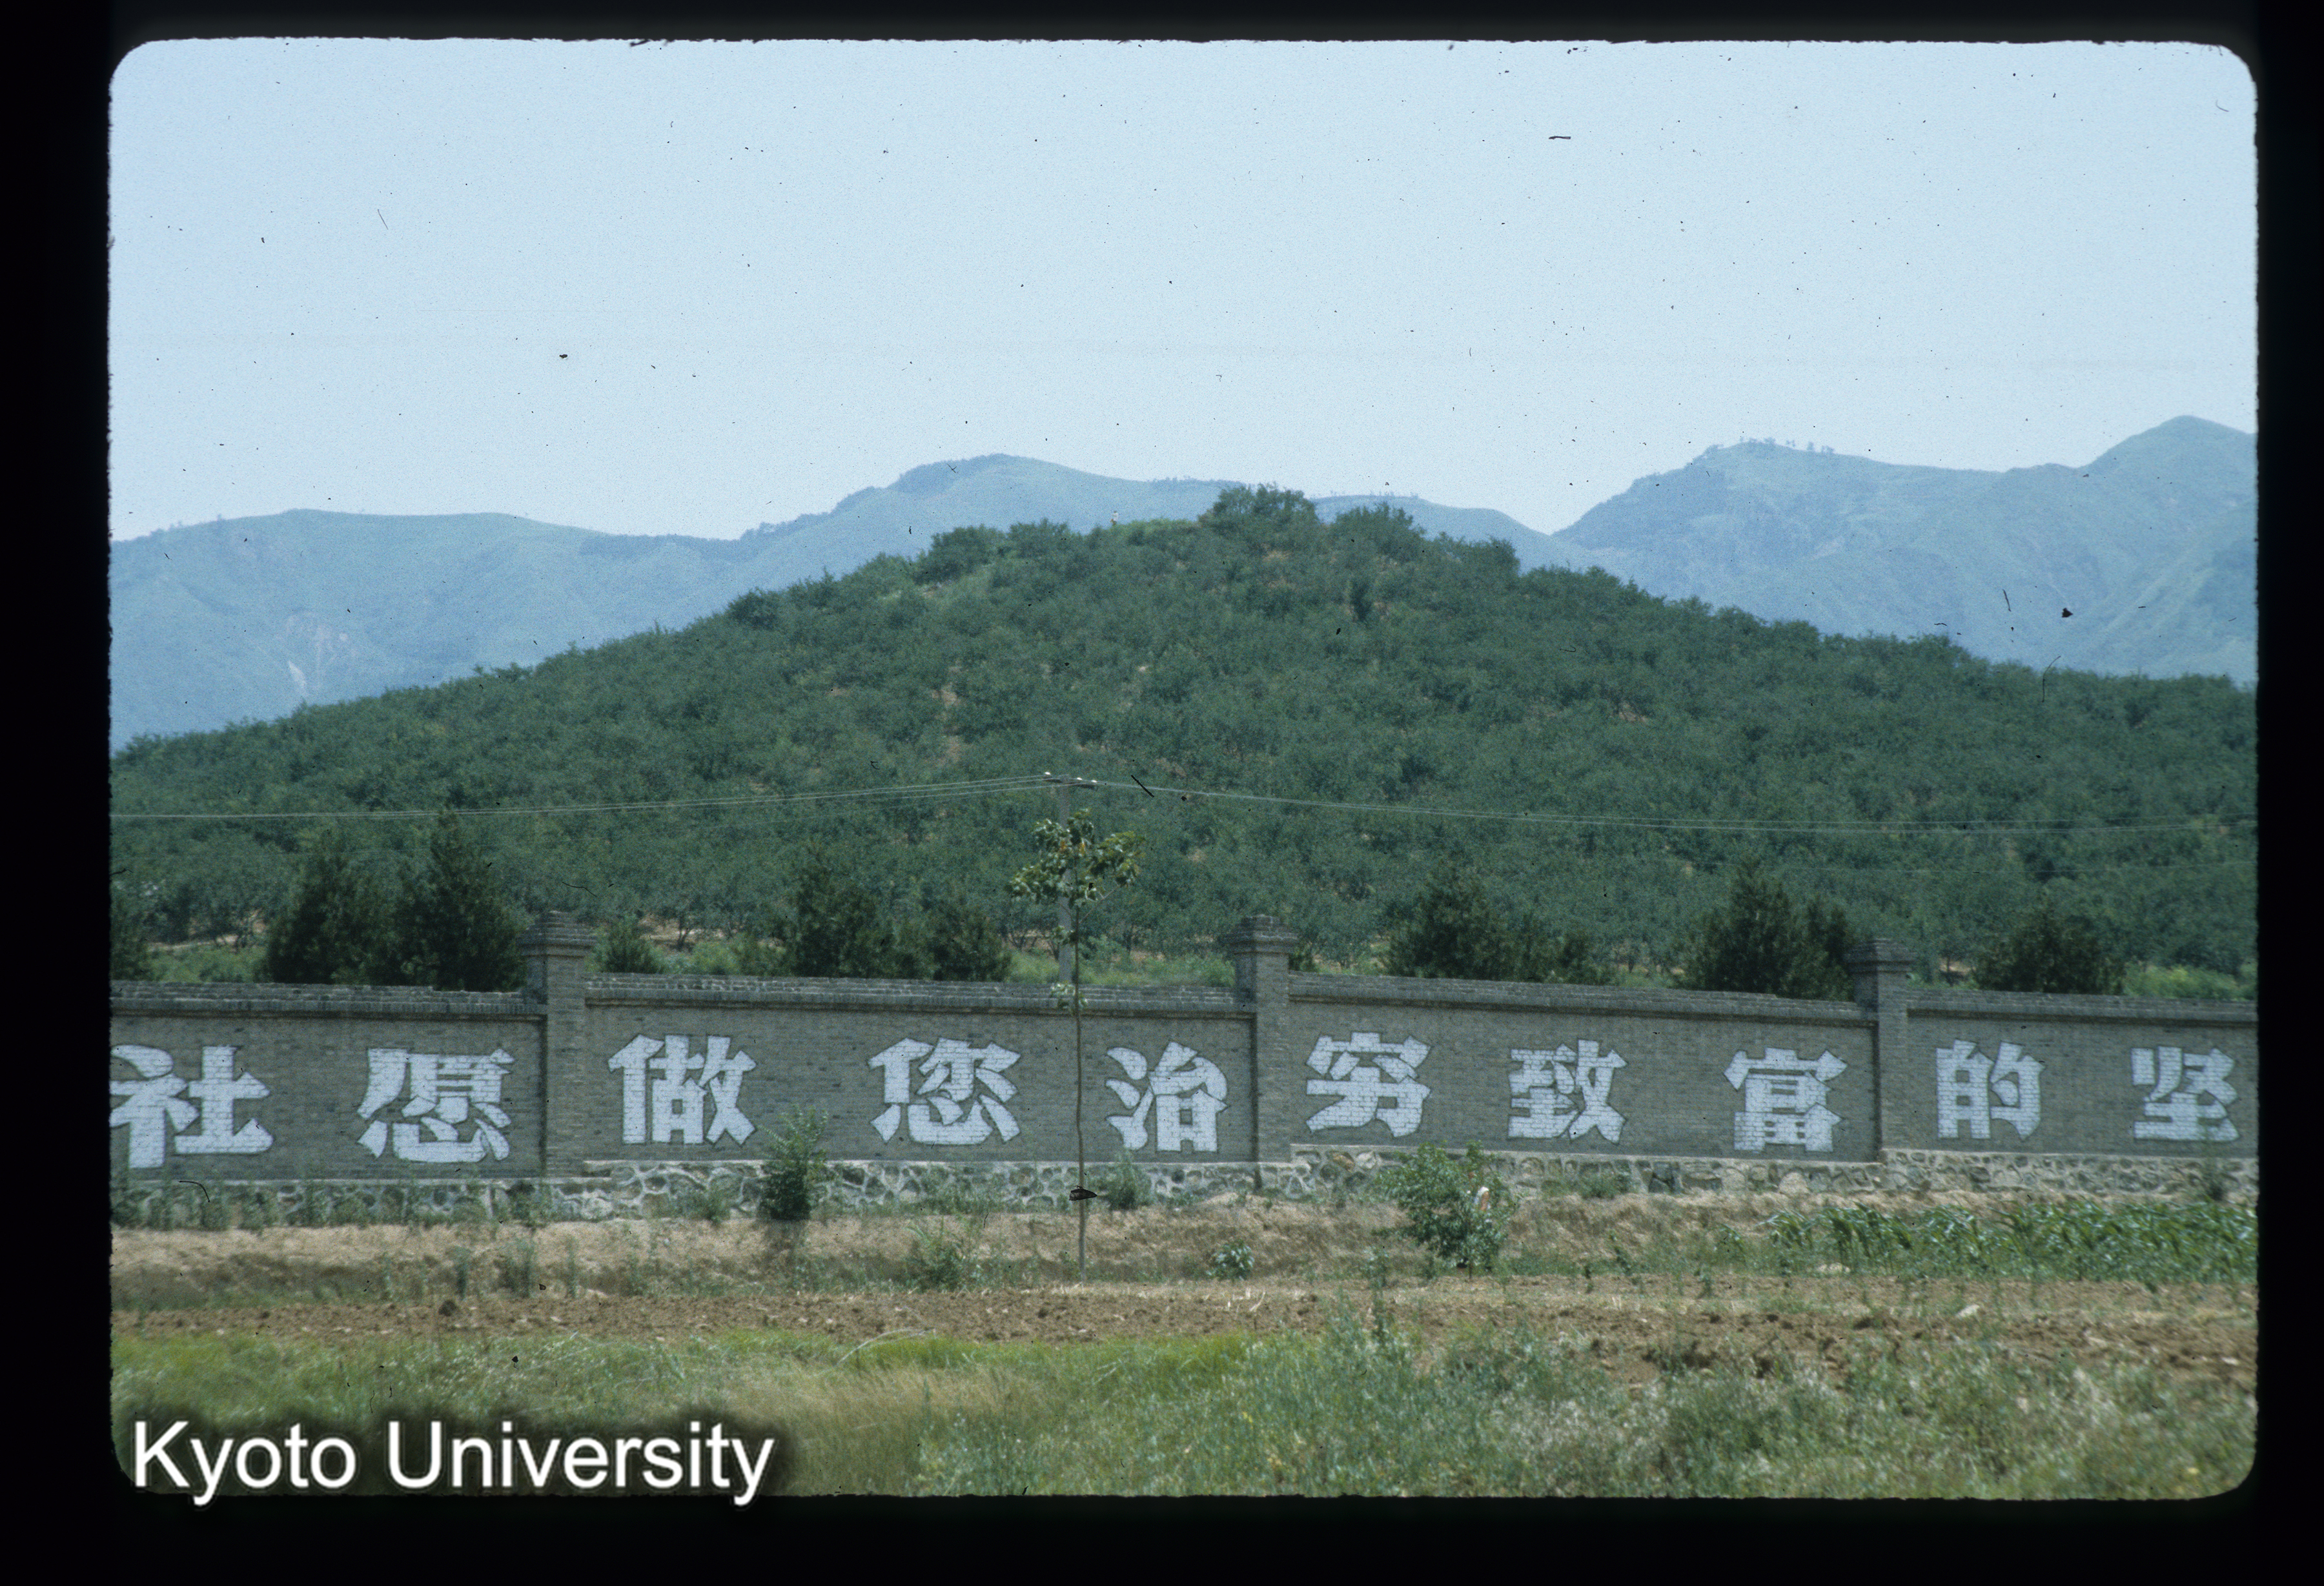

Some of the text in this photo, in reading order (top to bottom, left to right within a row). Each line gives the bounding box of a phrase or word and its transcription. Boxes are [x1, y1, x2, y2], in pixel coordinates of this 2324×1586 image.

[109, 1032, 2239, 1168] 社愿做您治穷致富的坚
